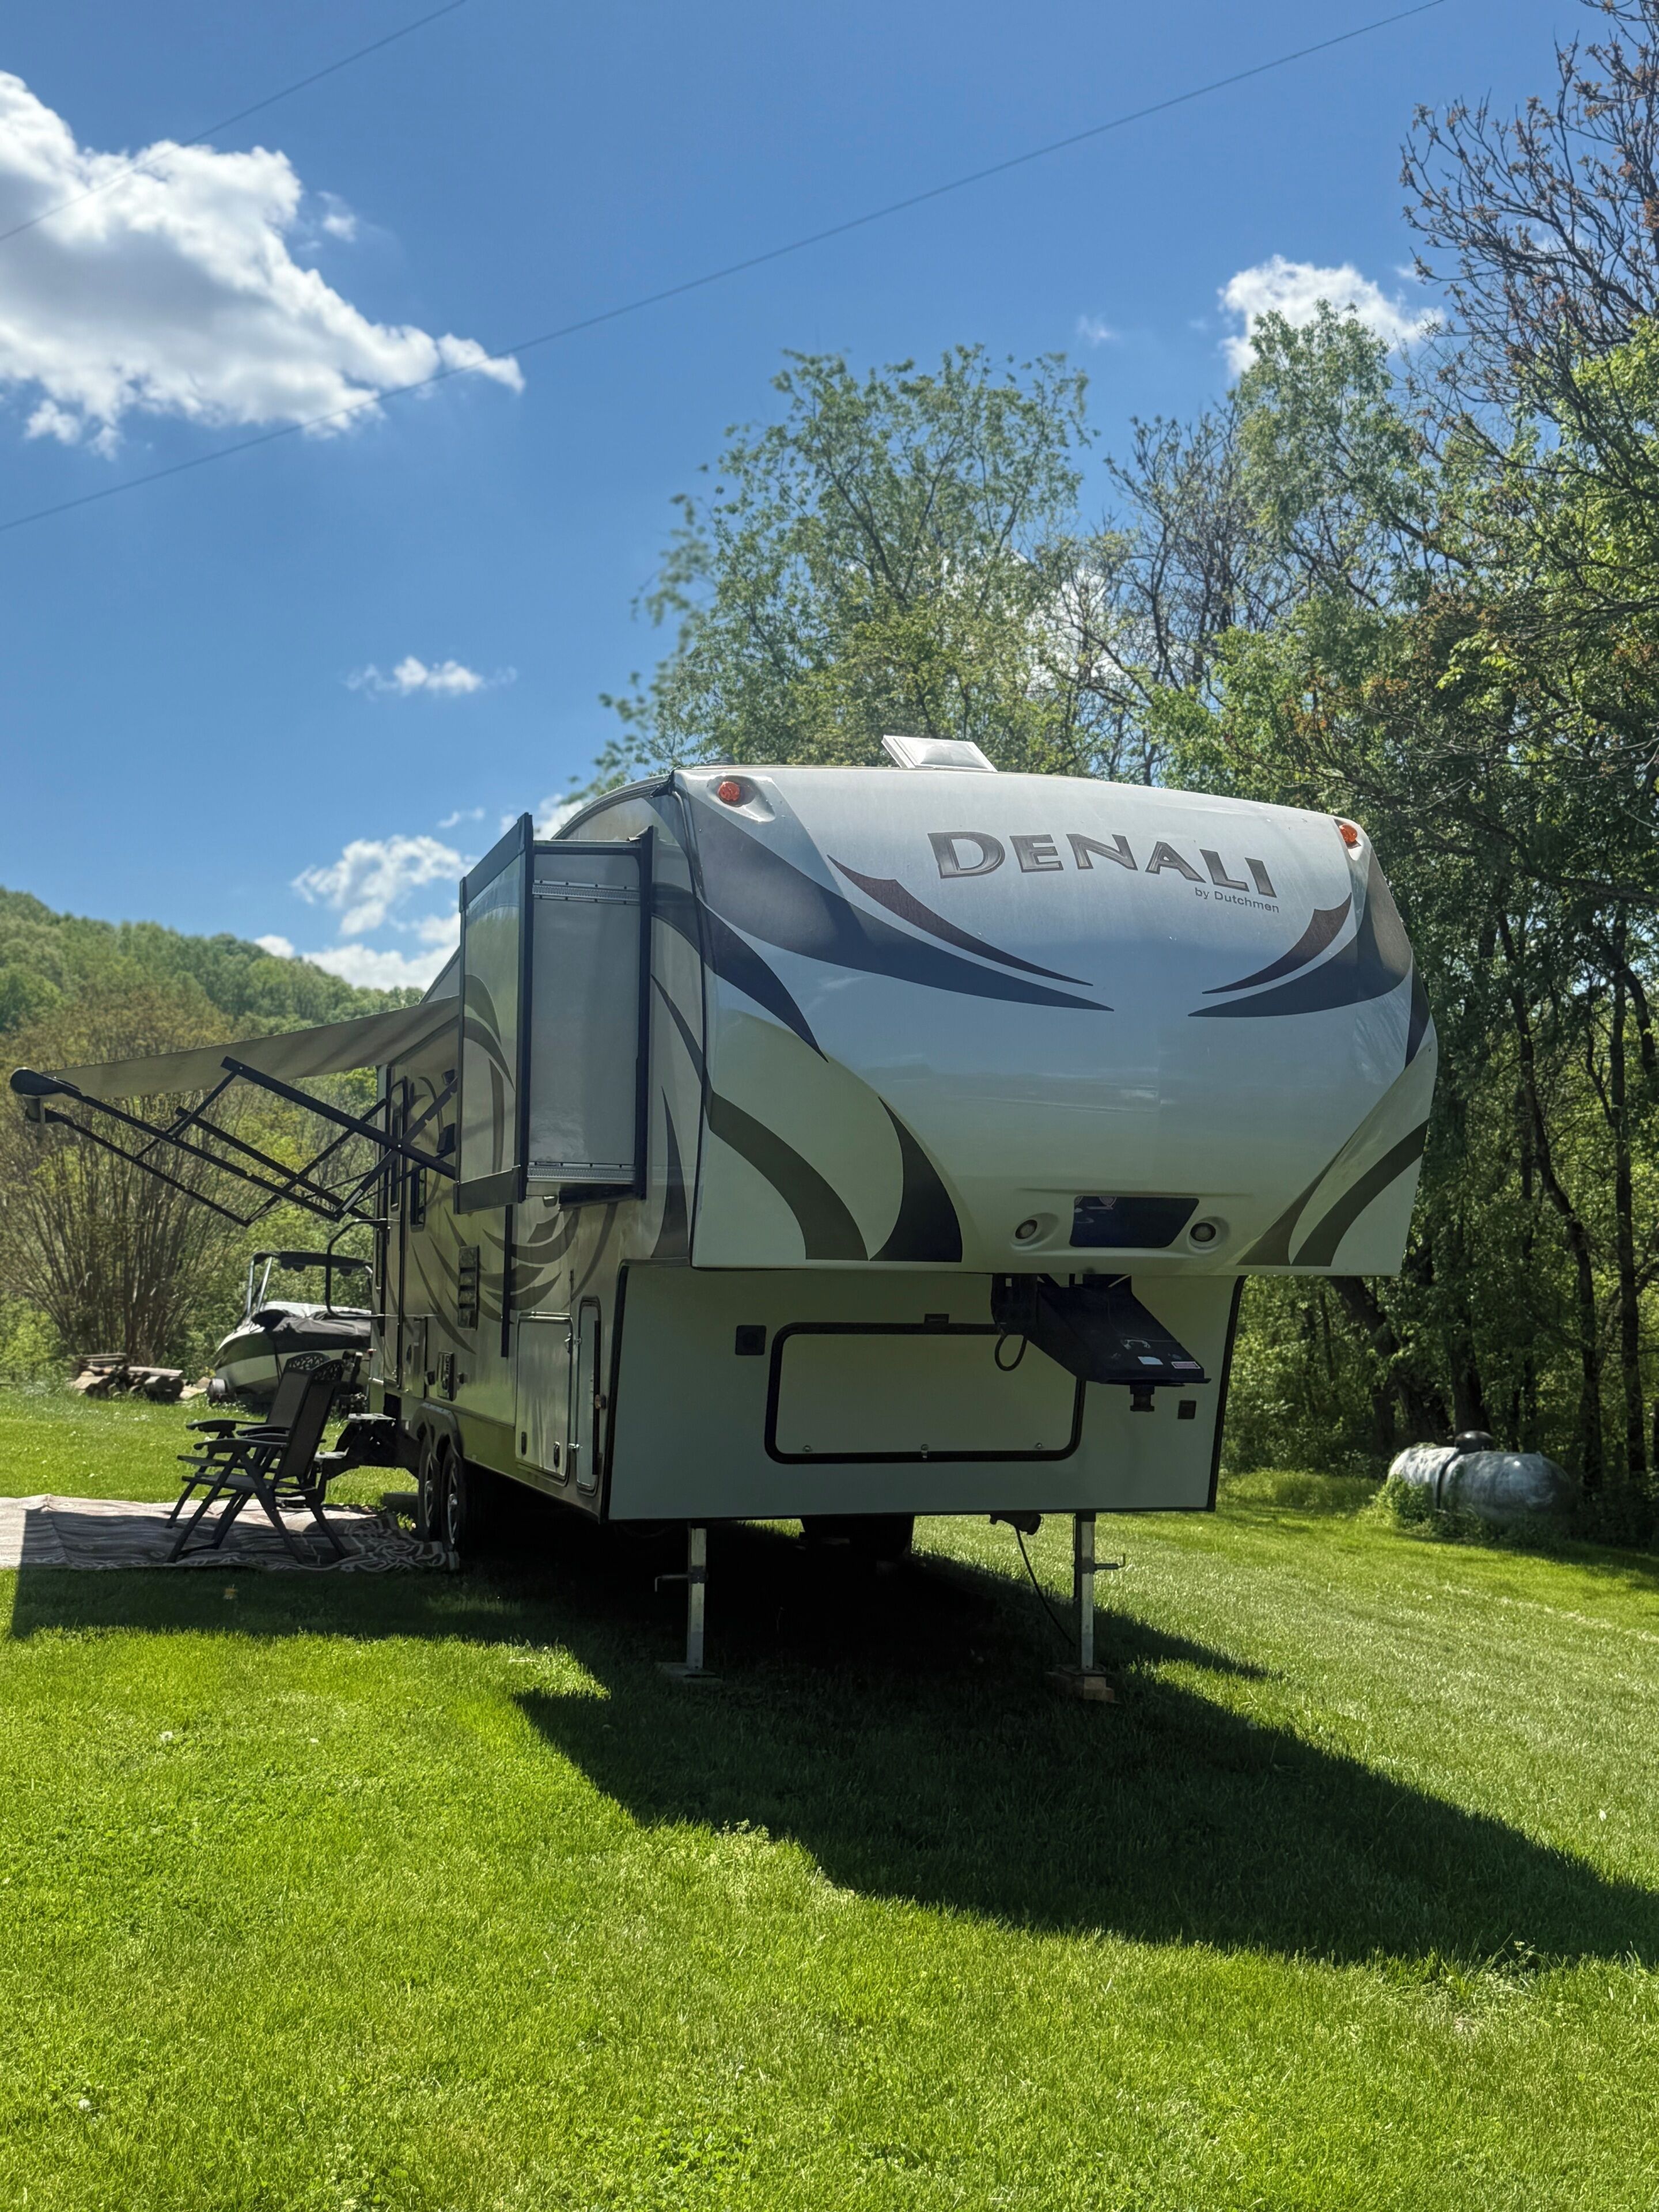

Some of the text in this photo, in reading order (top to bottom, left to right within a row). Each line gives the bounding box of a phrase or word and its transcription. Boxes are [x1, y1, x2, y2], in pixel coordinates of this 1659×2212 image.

[927, 831, 1278, 899] DENALI
[1195, 887, 1279, 913] by Dutchmen
